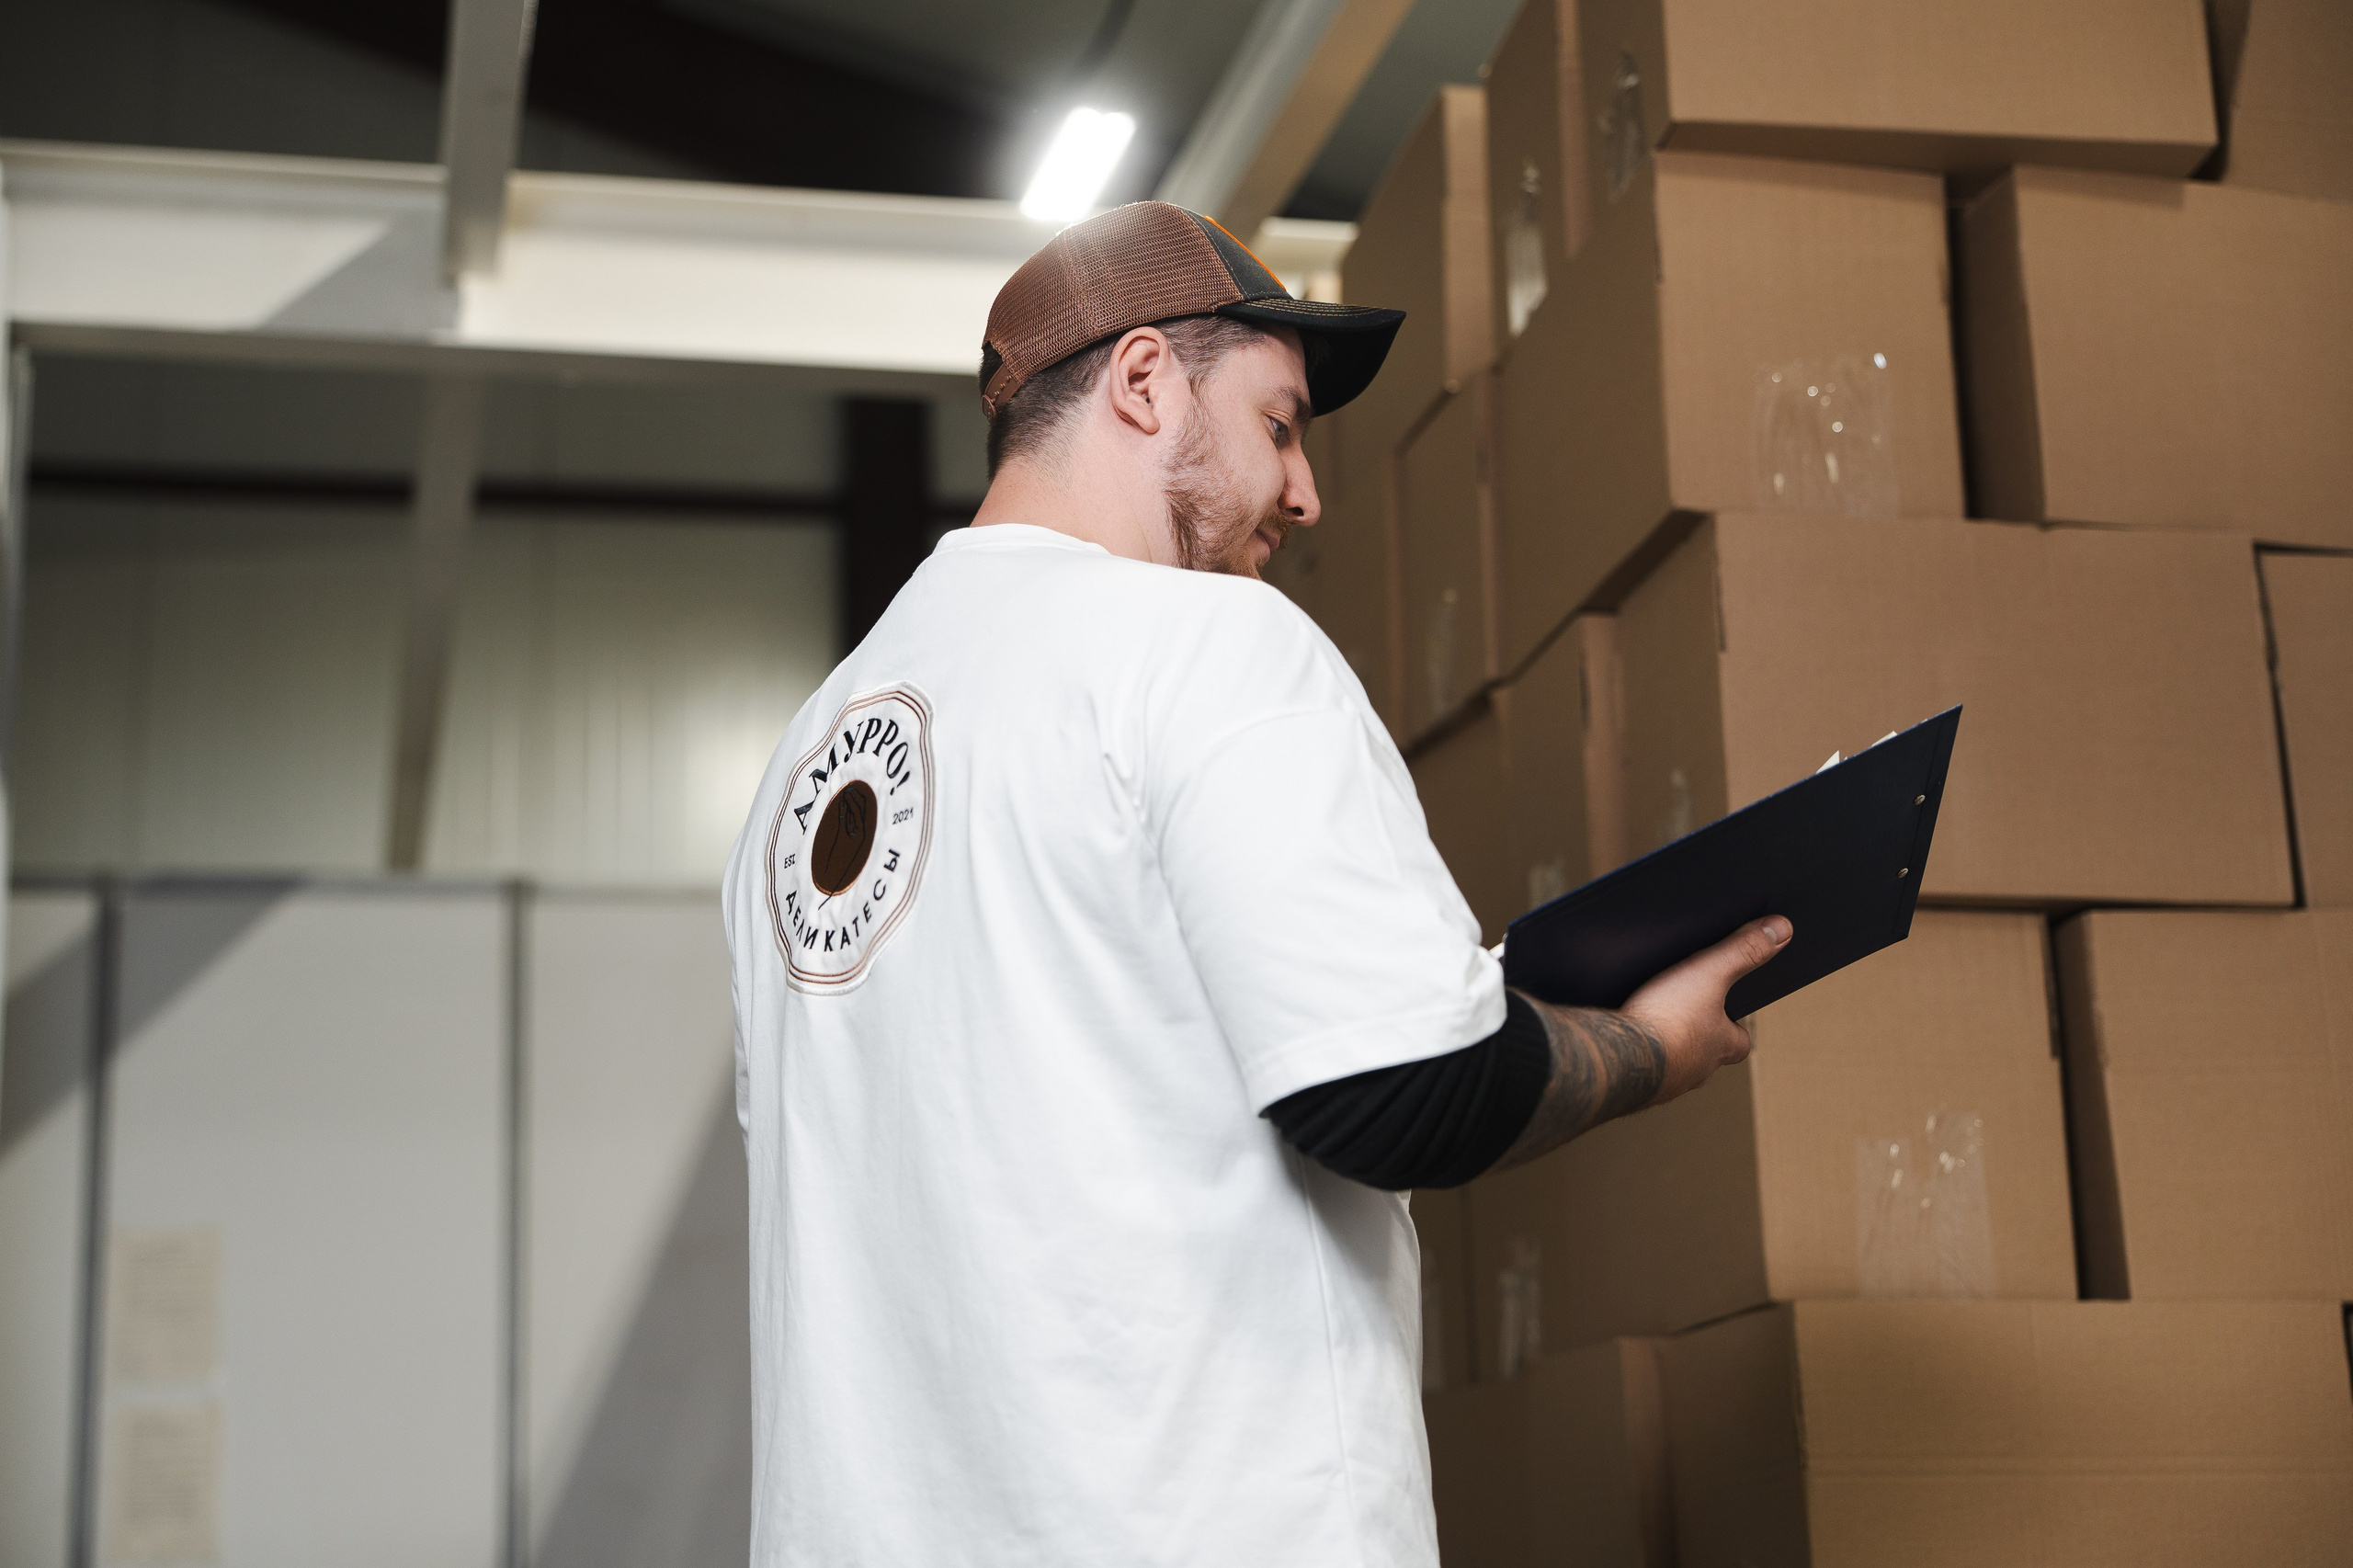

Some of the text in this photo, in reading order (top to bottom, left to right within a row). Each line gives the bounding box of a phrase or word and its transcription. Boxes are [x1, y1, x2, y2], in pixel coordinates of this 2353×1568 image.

[794, 718, 910, 835] АМУРРО!
[784, 807, 914, 869] EST 2021
[786, 848, 901, 952] ДЕЛИКАТЕСЫ
